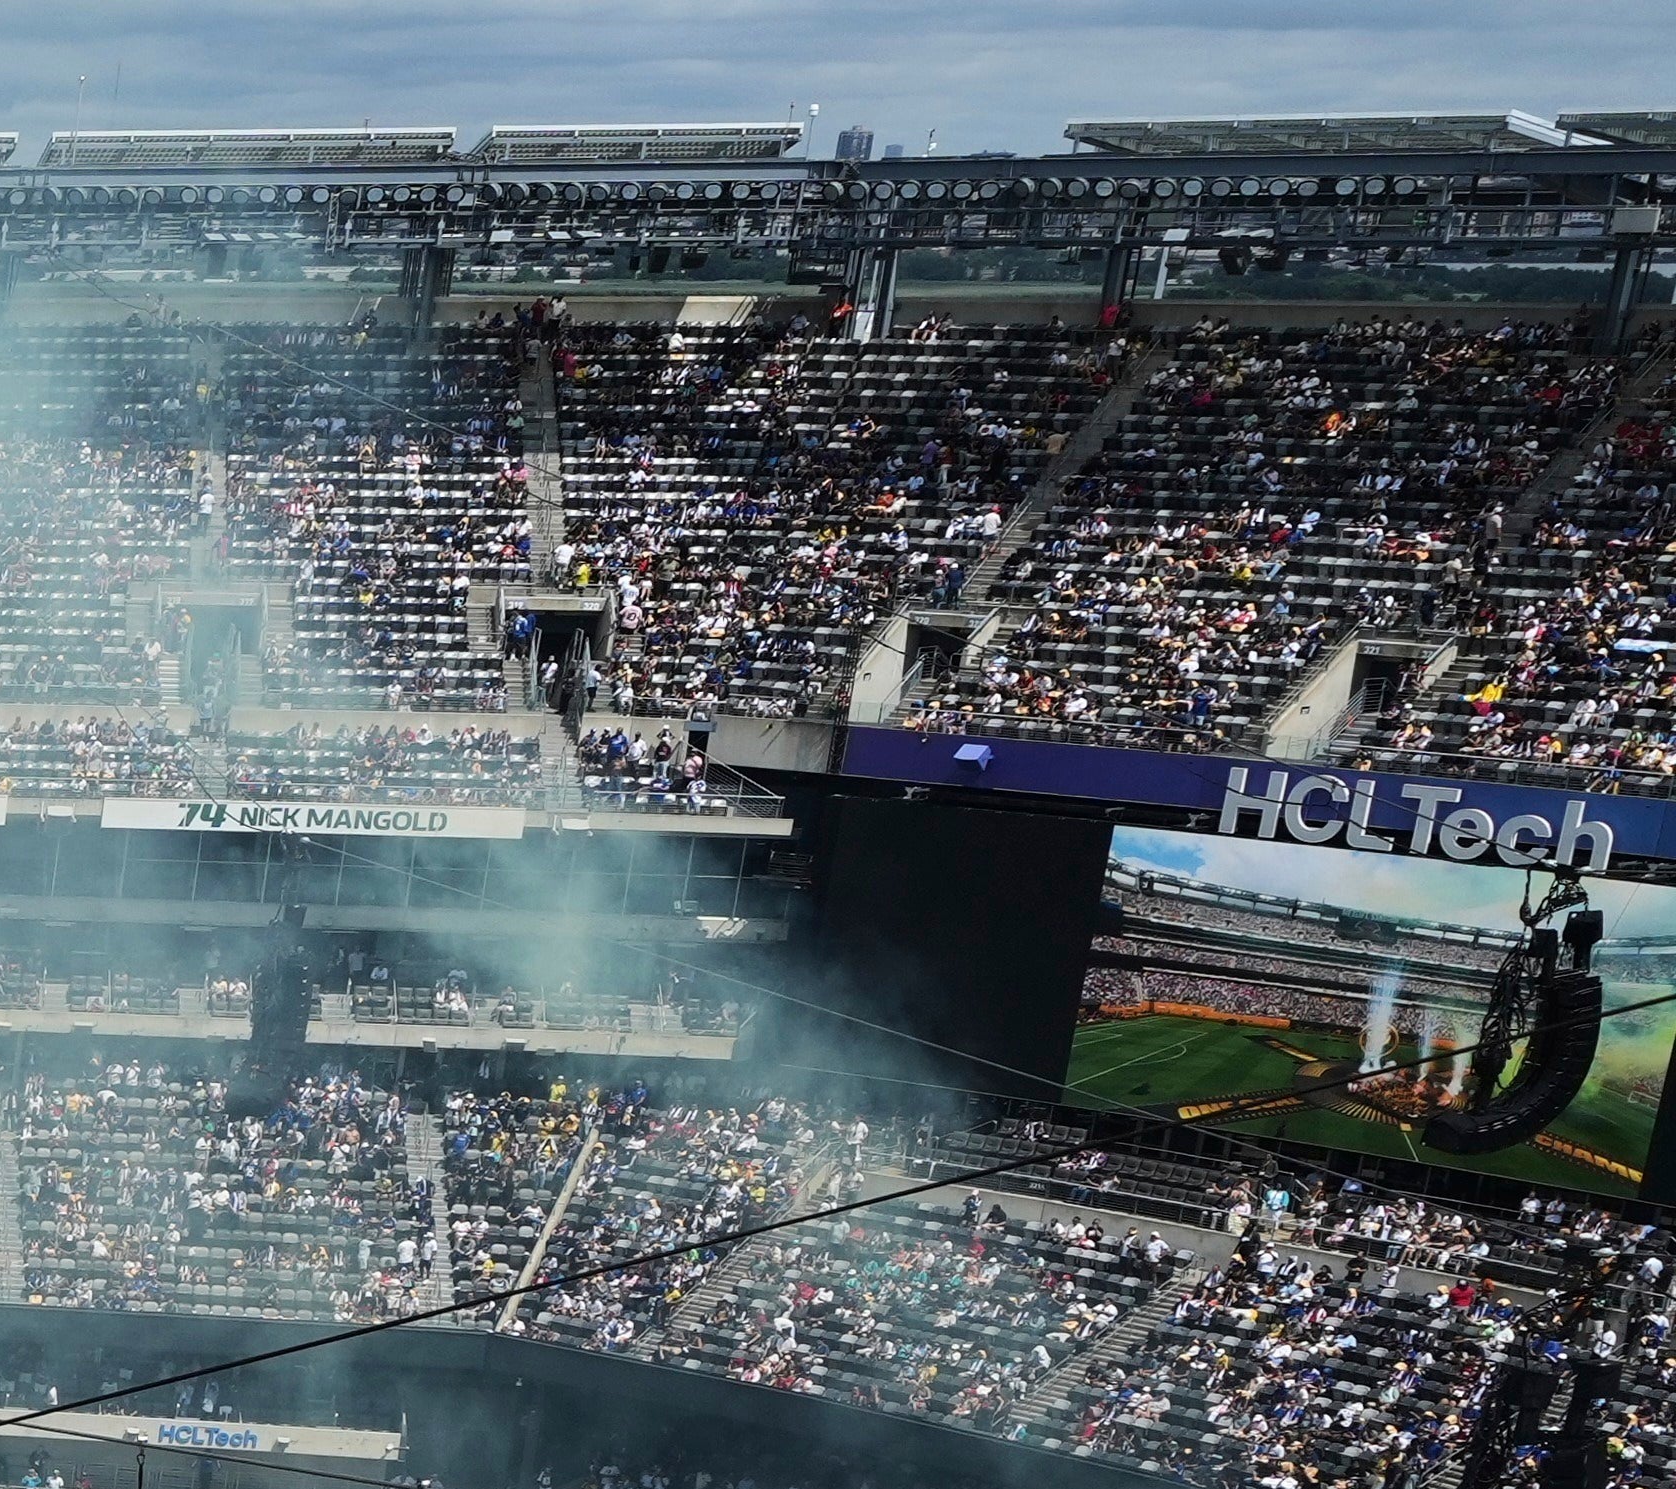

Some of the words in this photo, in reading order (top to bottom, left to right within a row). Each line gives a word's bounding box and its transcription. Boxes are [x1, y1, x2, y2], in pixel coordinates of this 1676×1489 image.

[178, 803, 228, 828] 74
[239, 805, 300, 829] NICK
[306, 807, 448, 832] MANGOLD
[1218, 766, 1615, 876] HCLTech
[157, 1424, 259, 1449] HCLTech
